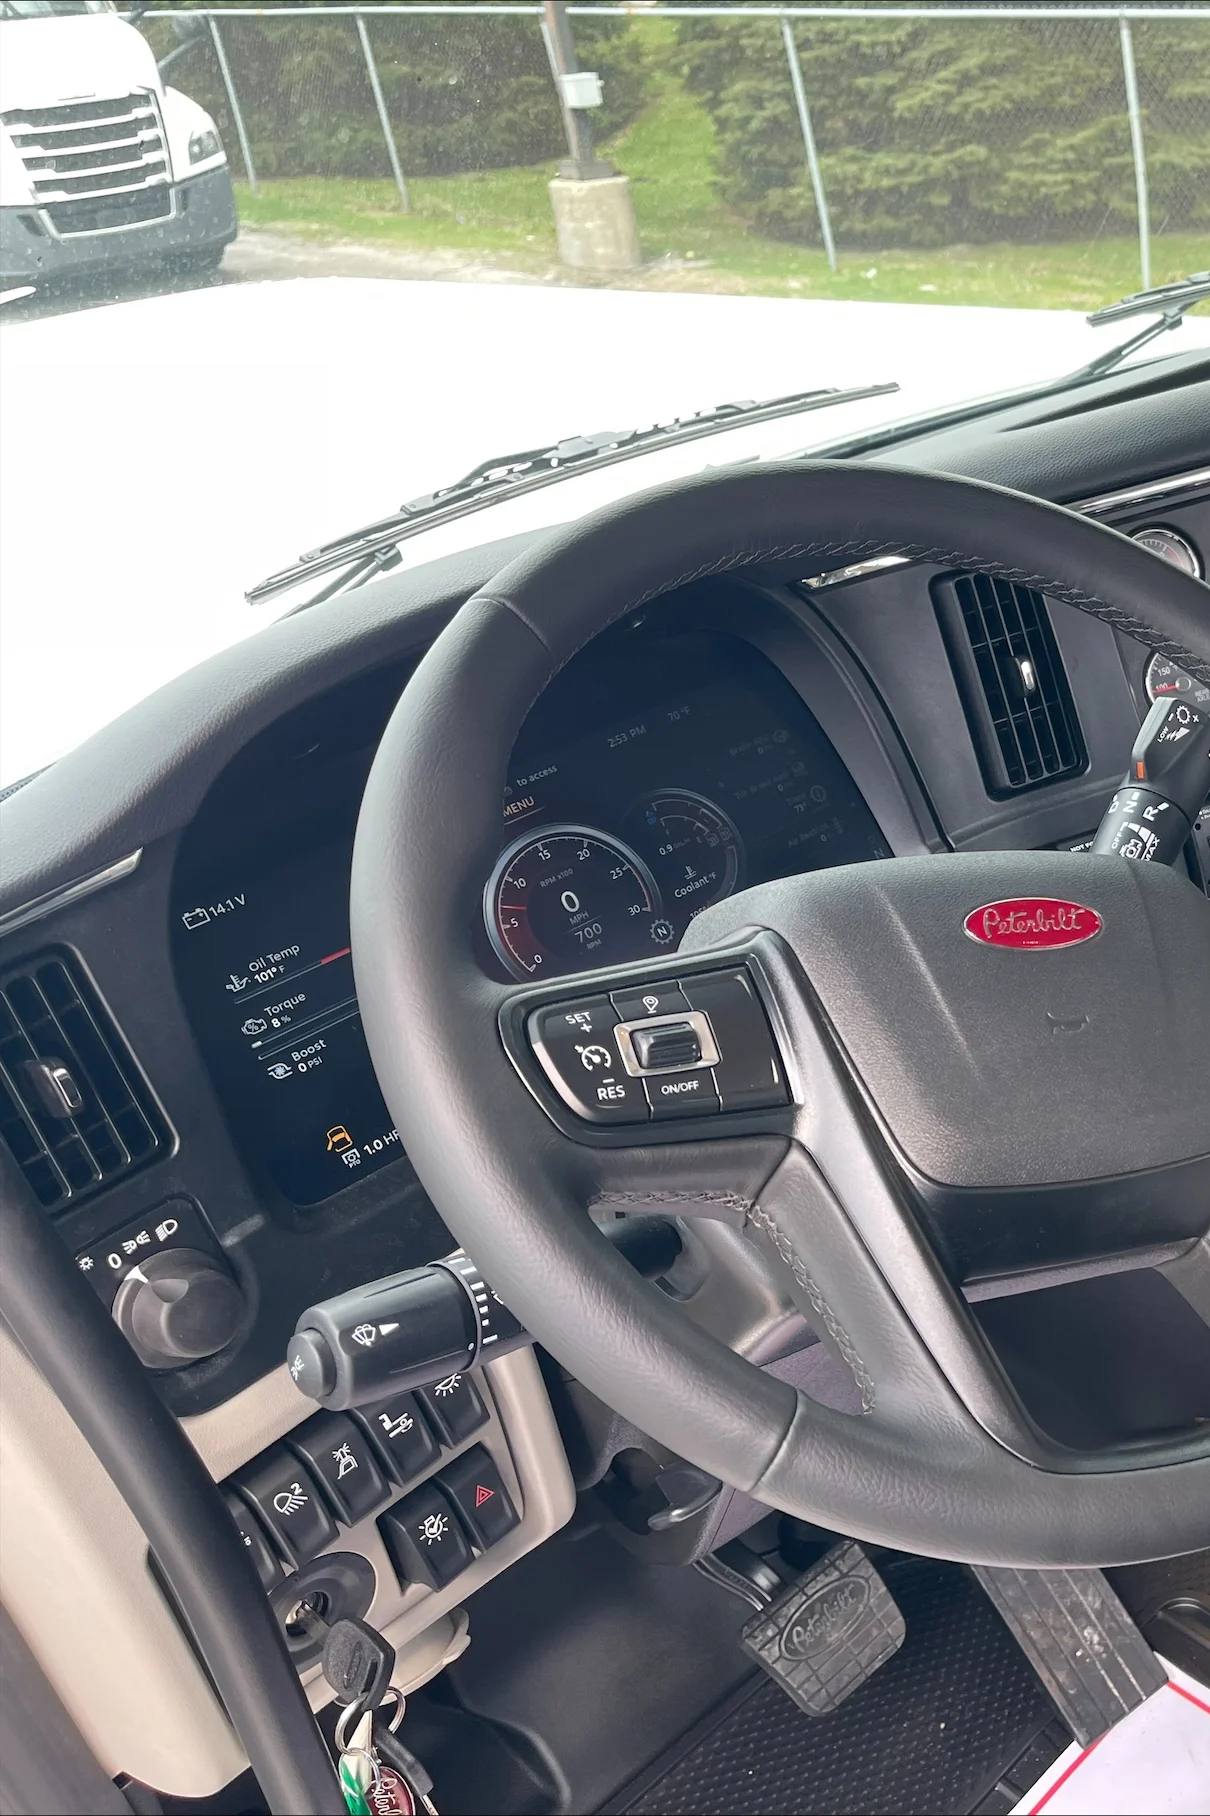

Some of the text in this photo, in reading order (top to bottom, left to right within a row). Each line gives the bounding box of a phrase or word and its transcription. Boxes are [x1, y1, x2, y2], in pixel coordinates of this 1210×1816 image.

[1158, 666, 1171, 677] 150
[629, 725, 647, 738] PM
[1157, 726, 1169, 743] LOW
[516, 765, 558, 787] to access
[503, 796, 535, 817] MENU
[1108, 801, 1159, 822] D N R
[1111, 831, 1122, 850] OFF
[538, 849, 551, 861] 15
[576, 848, 591, 861] 20
[609, 867, 623, 880] 25
[513, 877, 527, 890] 10
[540, 875, 557, 888] RPM
[674, 875, 710, 898] Coolant
[208, 893, 247, 917] 14.1 V
[560, 890, 580, 913] 0
[627, 904, 641, 917] 30
[510, 917, 519, 928] 5
[569, 911, 590, 926] MPH
[982, 908, 1086, 939] Peterbilt
[574, 922, 603, 944] 700
[656, 925, 668, 938] N
[586, 938, 602, 951] RPM
[248, 944, 301, 972] Oil Temp
[533, 954, 543, 964] 0
[263, 993, 307, 1017] Torque
[271, 1017, 282, 1029] 8
[564, 1011, 591, 1025] SET
[291, 1039, 327, 1062] Boost
[297, 1056, 323, 1073] 0 PSI
[597, 1085, 626, 1101] RES
[660, 1080, 700, 1095] ON/OFF
[363, 1139, 384, 1155] 1.0
[348, 1158, 362, 1169] PTO
[792, 1583, 858, 1653] Peterbilt
